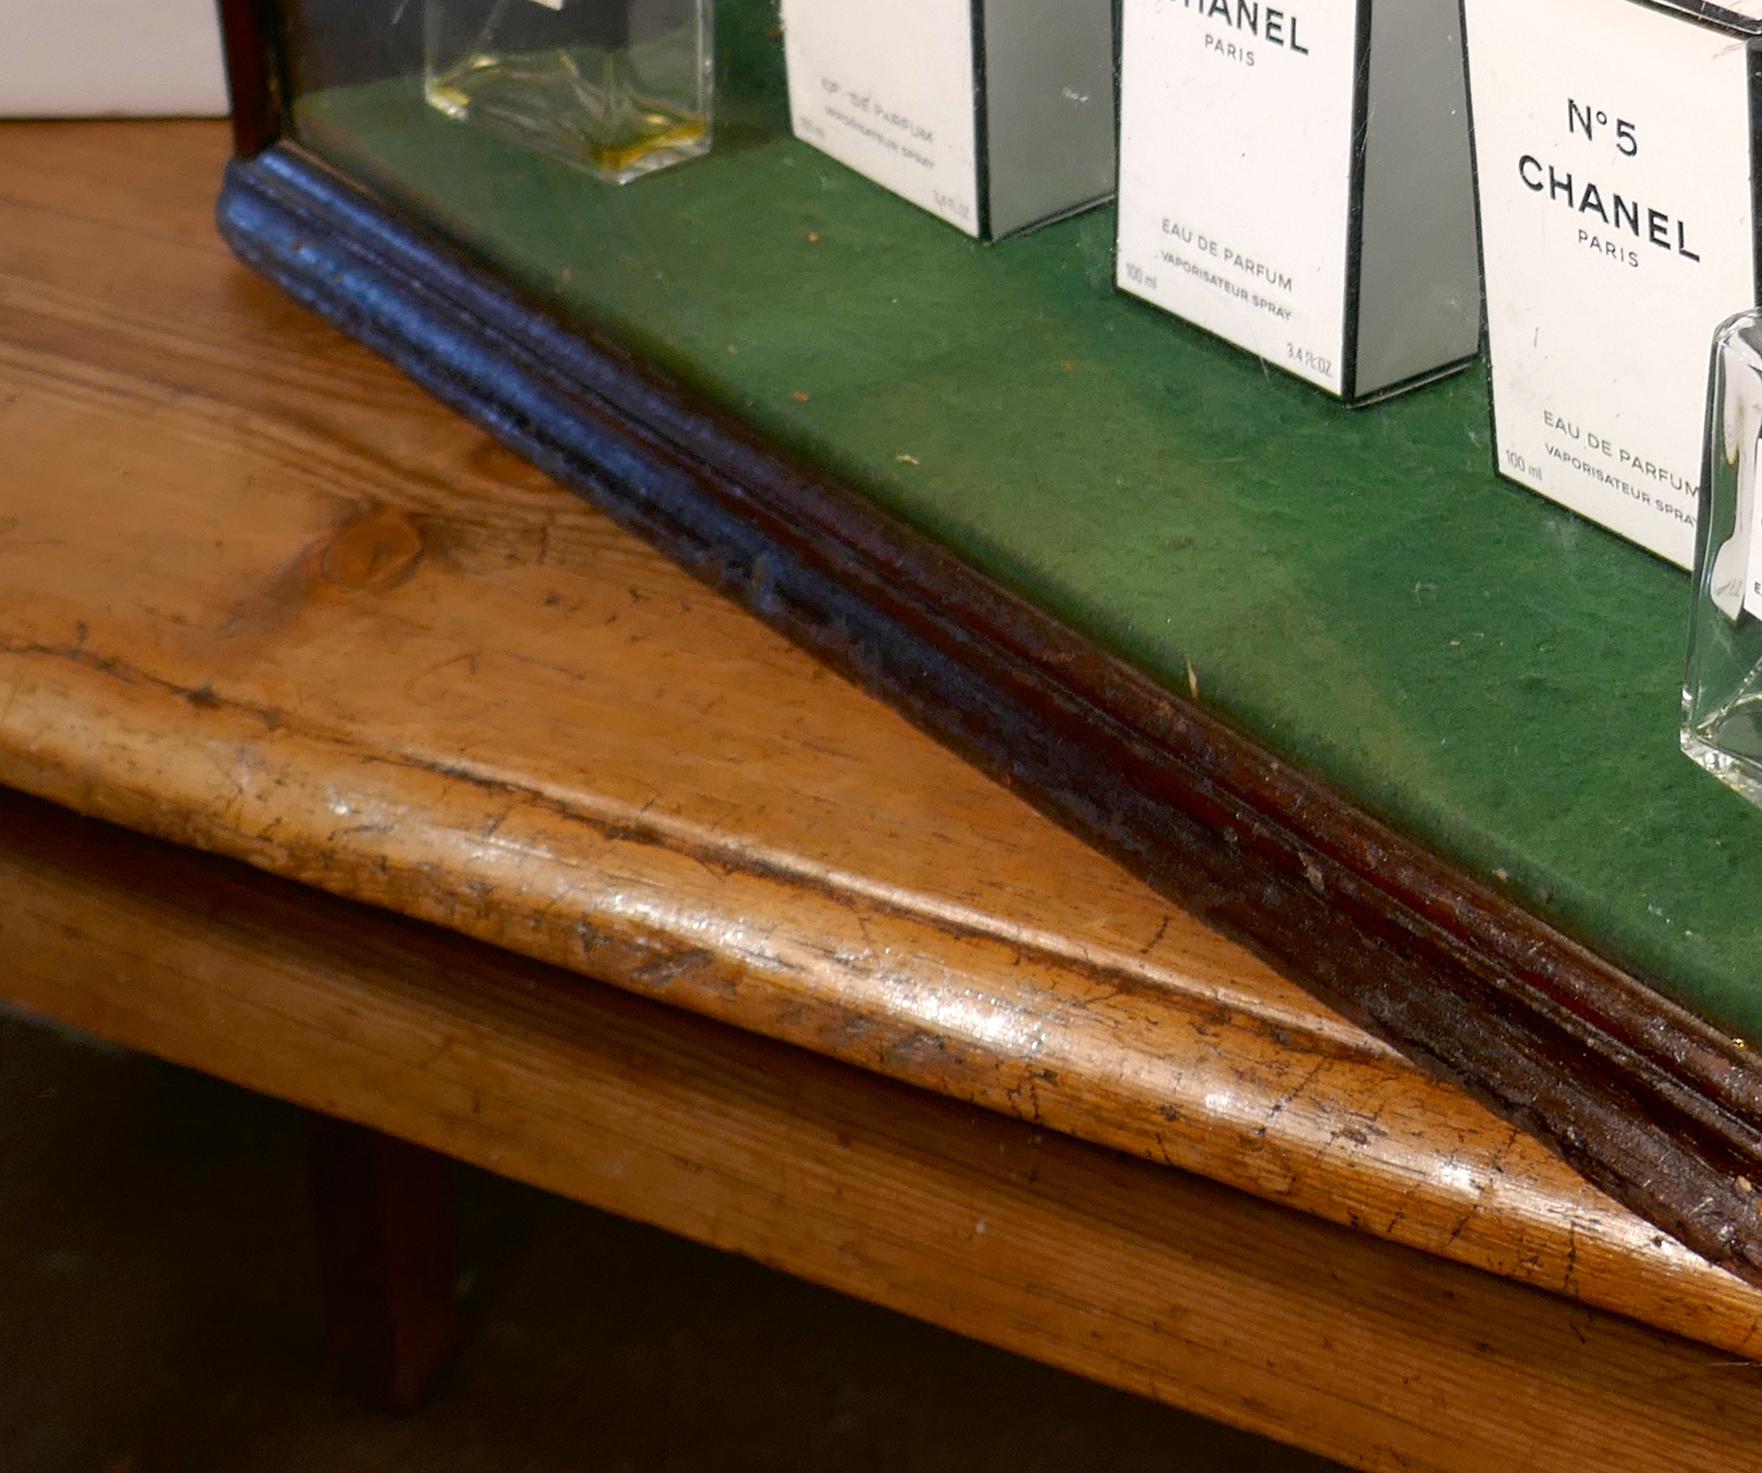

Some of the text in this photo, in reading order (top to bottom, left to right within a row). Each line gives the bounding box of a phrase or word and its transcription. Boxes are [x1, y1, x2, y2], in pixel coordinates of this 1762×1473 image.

[1205, 34, 1255, 67] PARIS
[1518, 154, 1700, 263] CHANEL
[1161, 218, 1292, 292] EAU DE PARFUM
[1578, 229, 1639, 268] PARIS
[1161, 250, 1292, 321] VAPORISATEUR SPRAY
[1505, 449, 1542, 481] 100 ml
[1543, 409, 1700, 498] EAU DE PARFUM
[1544, 441, 1650, 505] VAPORISATEUR
